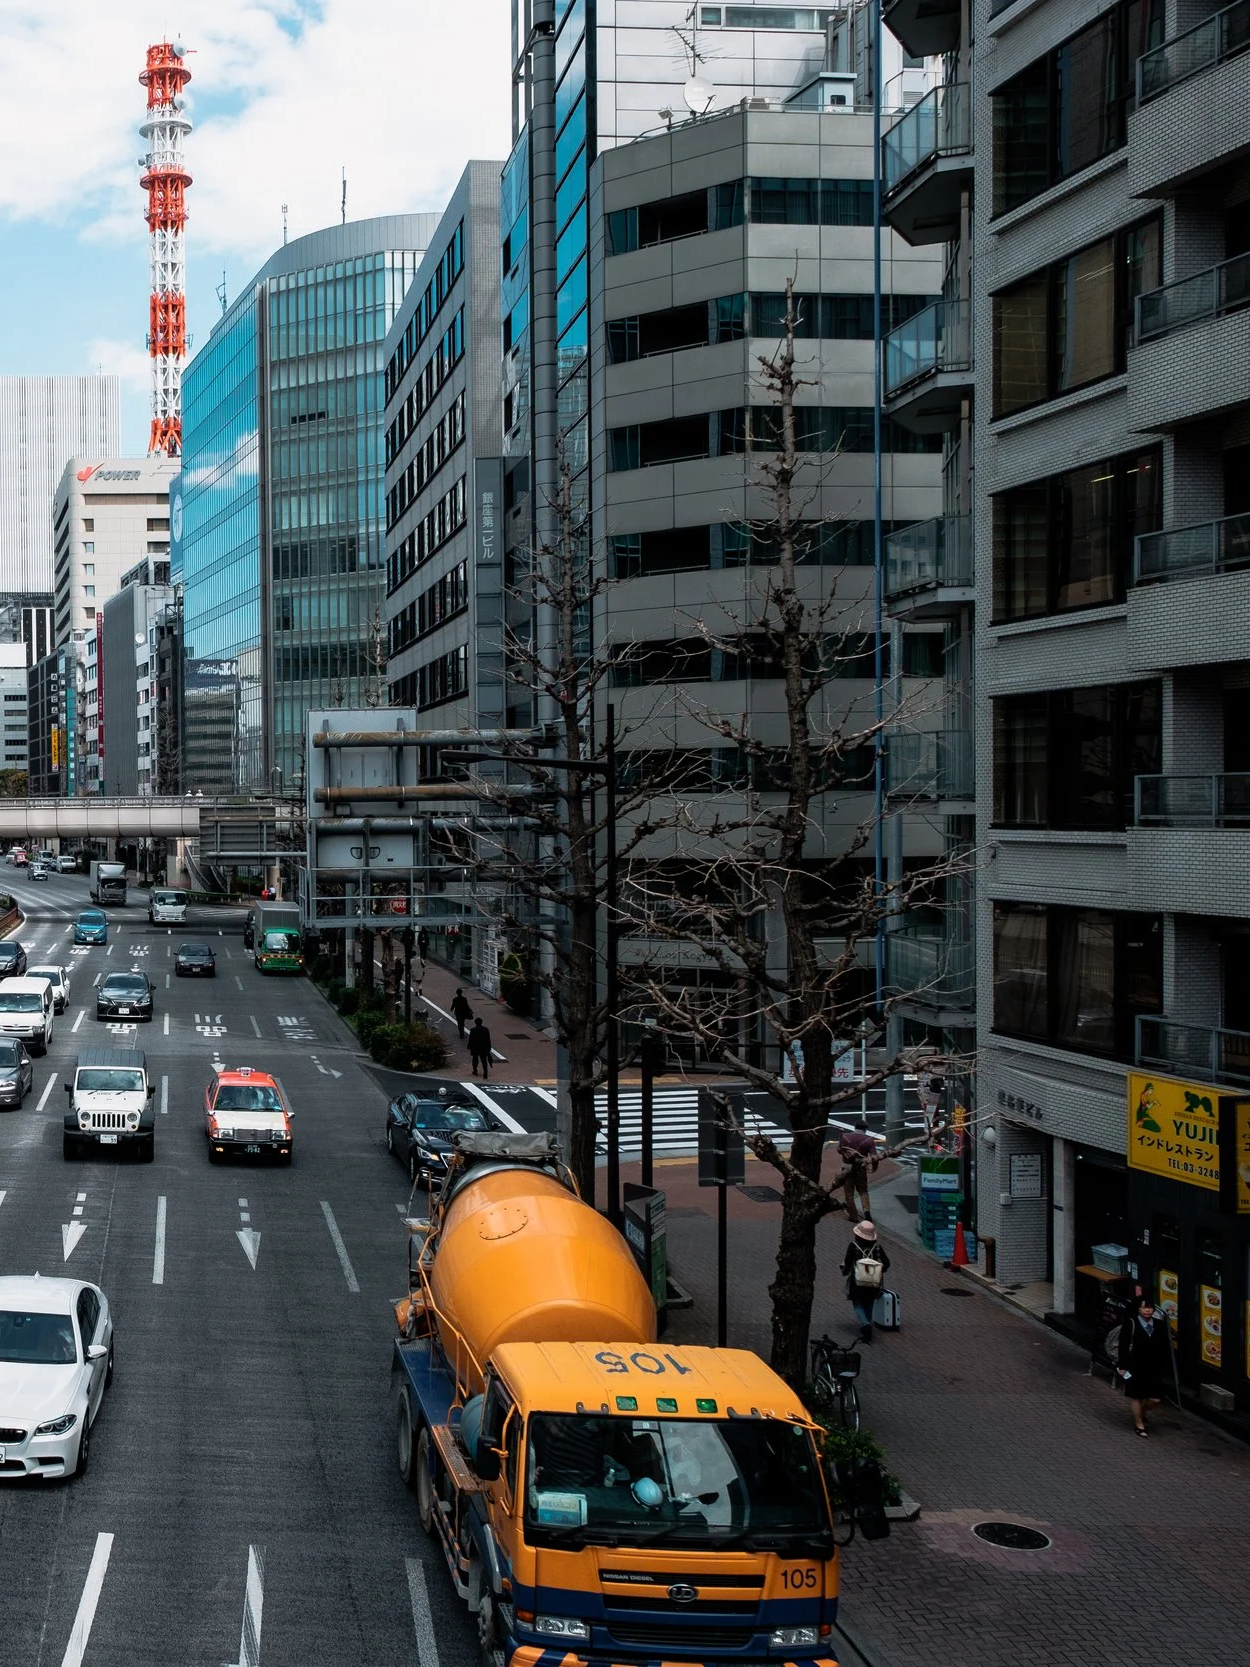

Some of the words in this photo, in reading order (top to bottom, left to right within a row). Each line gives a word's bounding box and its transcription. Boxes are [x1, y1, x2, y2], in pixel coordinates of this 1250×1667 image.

[482, 491, 494, 559] 銀座第一ビル
[1137, 1135, 1214, 1162] インドレストラン
[923, 1176, 957, 1186] FamilyMart
[595, 1351, 692, 1375] 105
[629, 1574, 655, 1582] DIESEL
[780, 1567, 817, 1590] 105
